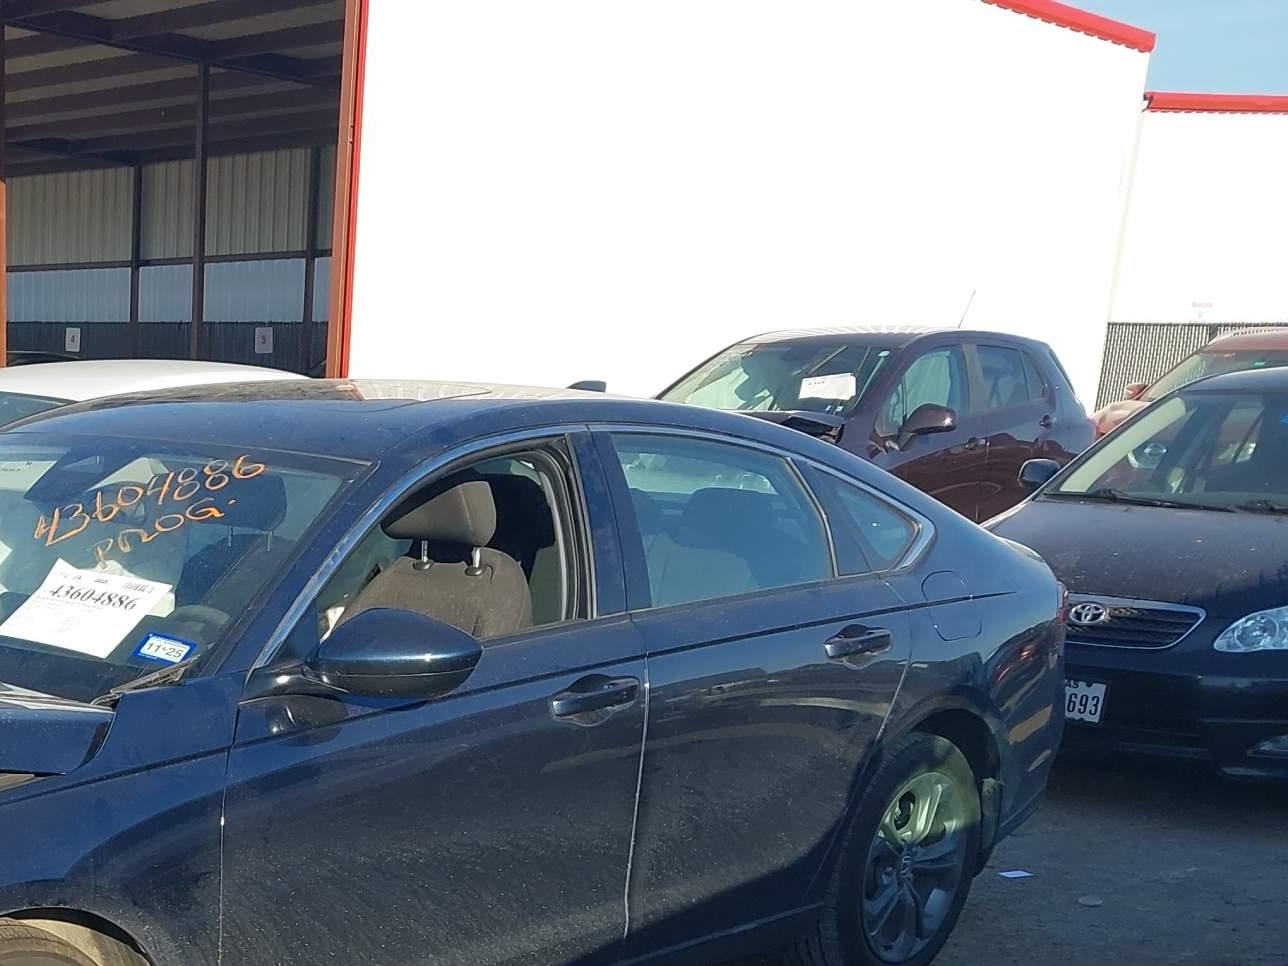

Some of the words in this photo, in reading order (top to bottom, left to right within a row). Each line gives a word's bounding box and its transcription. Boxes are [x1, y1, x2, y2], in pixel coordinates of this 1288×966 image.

[34, 454, 265, 547] 43604886
[49, 584, 144, 611] 43604886
[1067, 692, 1100, 716] 693
